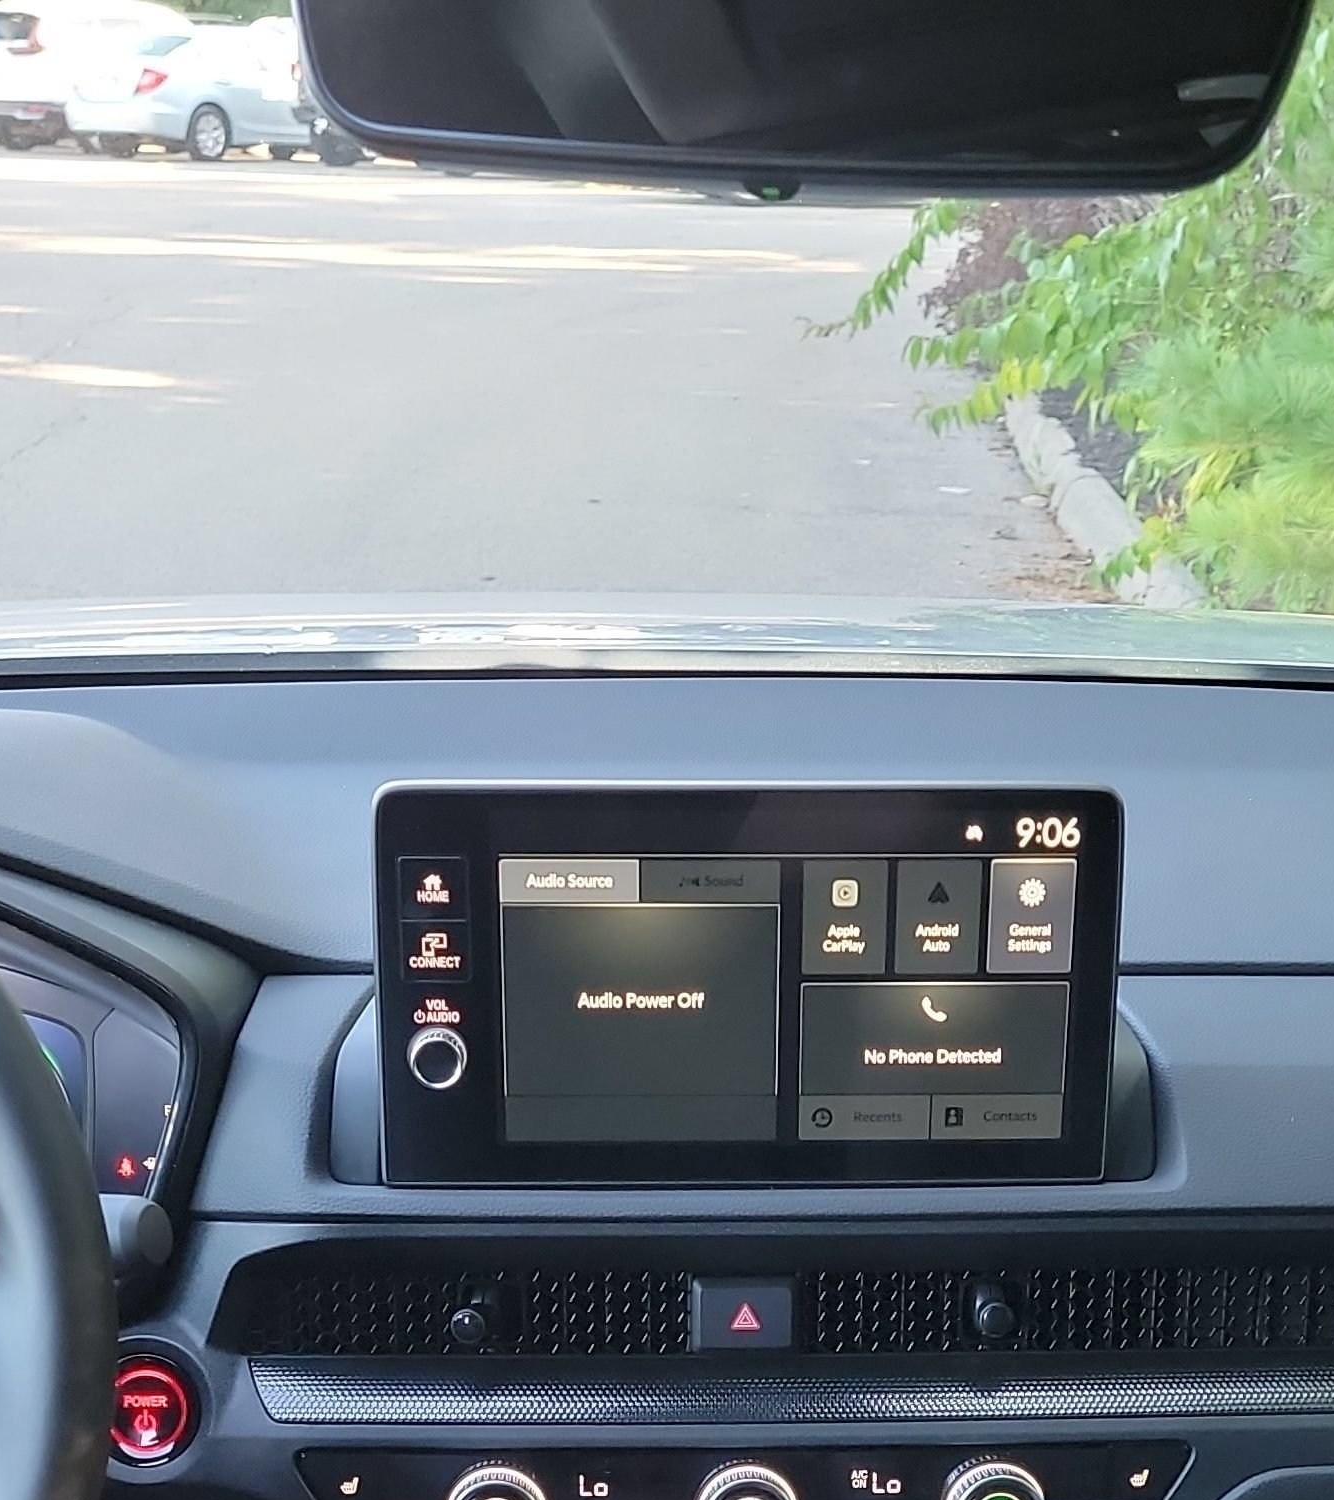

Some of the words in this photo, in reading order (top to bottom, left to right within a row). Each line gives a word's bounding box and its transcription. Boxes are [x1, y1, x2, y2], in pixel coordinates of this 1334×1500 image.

[1016, 817, 1080, 848] 9:06
[526, 873, 565, 888] Audio
[568, 874, 613, 888] Source
[705, 875, 744, 887] Sound
[417, 891, 449, 902] HOME
[827, 924, 860, 938] Apple
[915, 924, 959, 937] Android
[1009, 924, 1051, 936] General
[823, 940, 865, 954] CarPlay
[923, 940, 950, 952] Auto
[1008, 939, 1051, 953] Settings
[409, 957, 460, 968] CONNECT
[426, 1000, 448, 1010] VOL
[578, 992, 623, 1009] Audio
[626, 992, 674, 1009] Power
[677, 992, 705, 1008] Off
[426, 1012, 460, 1023] AUDIO
[864, 1049, 886, 1064] No
[889, 1049, 933, 1064] Phone
[937, 1048, 1001, 1064] Detected
[854, 1111, 902, 1122] Recents
[983, 1111, 1037, 1122] Contacts
[123, 1395, 168, 1408] POWER
[851, 1470, 868, 1479] A/C
[579, 1475, 608, 1497] Lo
[852, 1479, 867, 1489] ON
[873, 1473, 901, 1494] Lo
